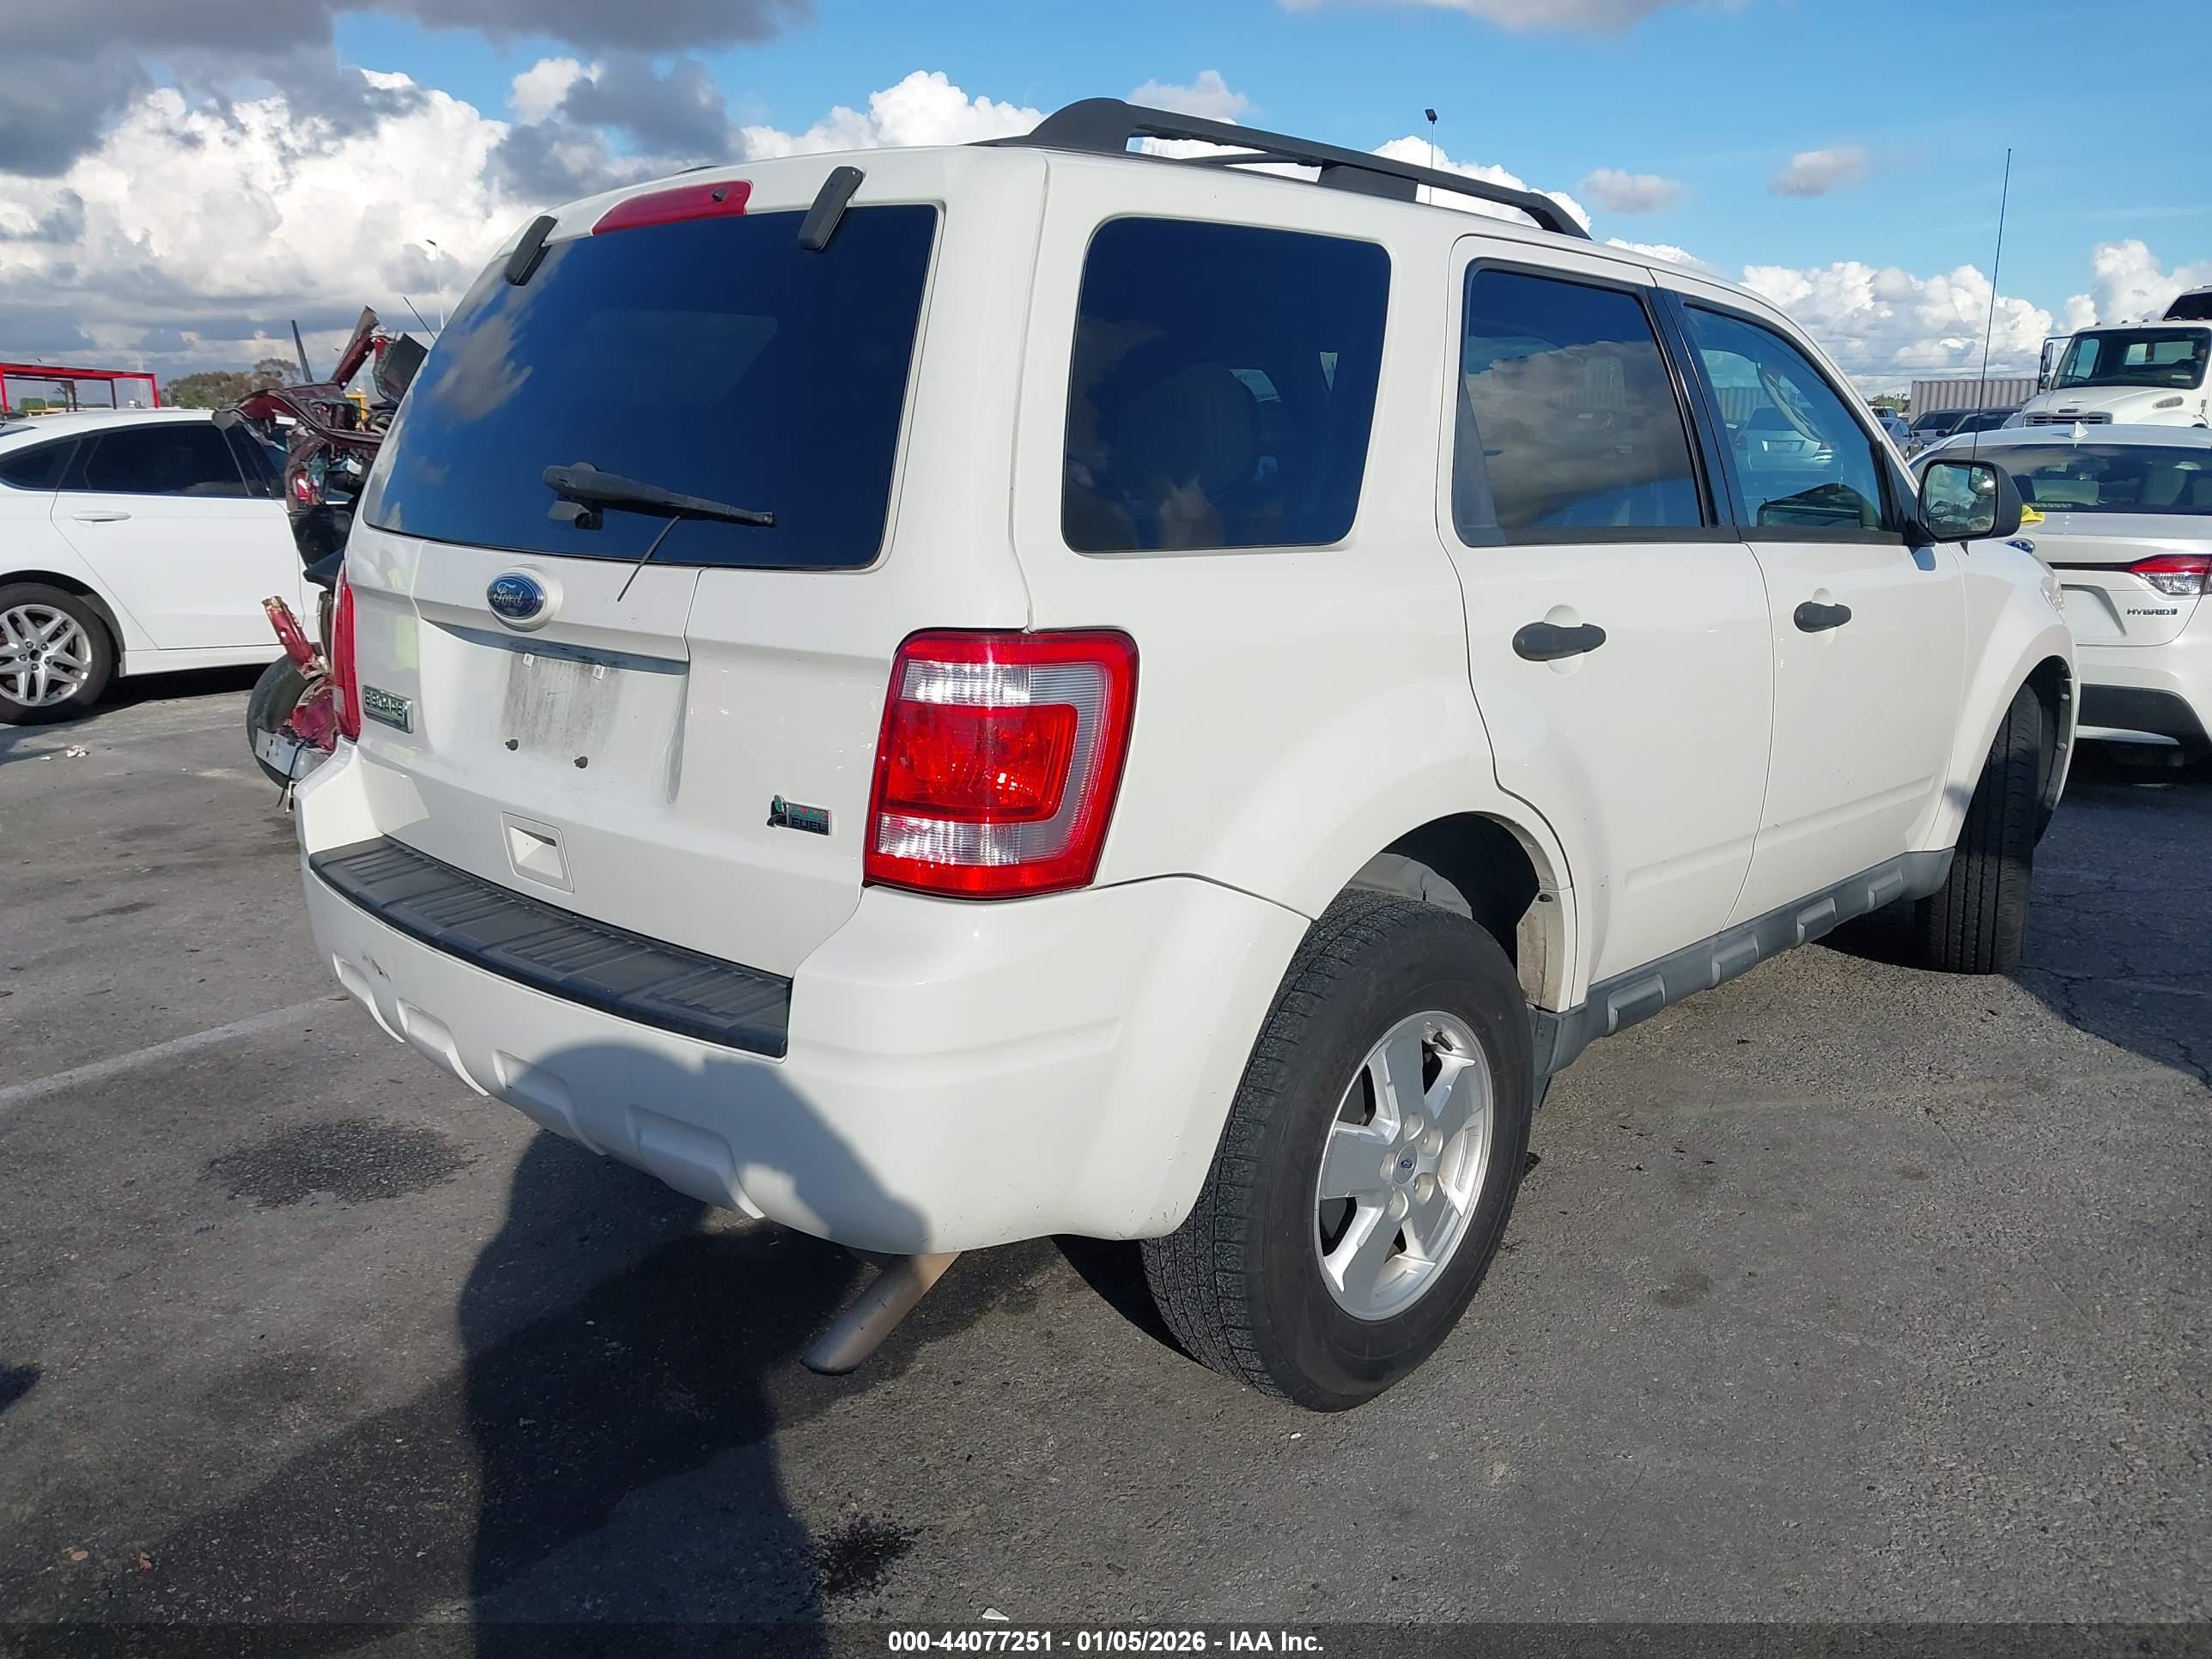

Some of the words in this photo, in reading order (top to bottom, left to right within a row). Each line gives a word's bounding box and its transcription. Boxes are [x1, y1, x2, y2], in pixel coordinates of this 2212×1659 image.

[494, 581, 525, 605] Ford
[2126, 607, 2171, 616] HYBRID
[365, 691, 405, 717] ESCAPE
